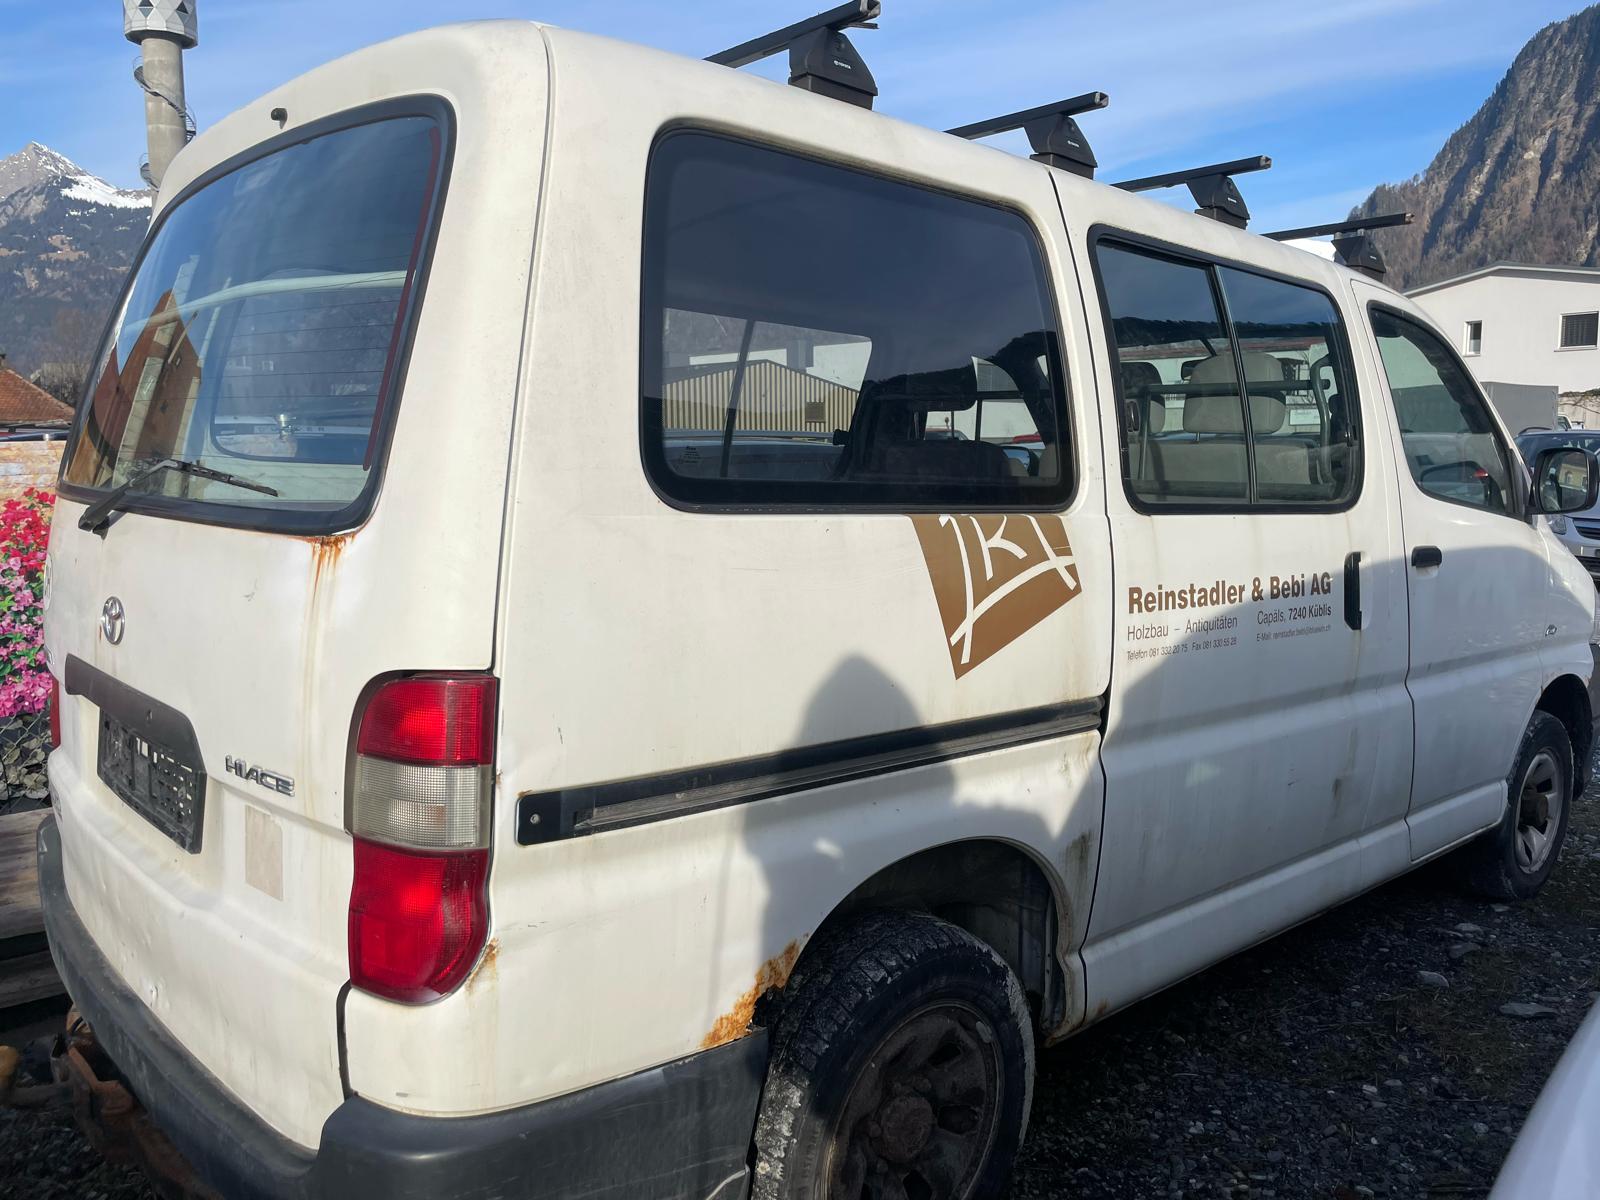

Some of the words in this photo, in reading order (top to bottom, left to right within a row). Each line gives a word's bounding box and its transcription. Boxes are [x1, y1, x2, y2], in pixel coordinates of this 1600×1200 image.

[1128, 579, 1245, 614] Reinstadler
[1251, 576, 1264, 602] &
[1270, 573, 1305, 600] Bebi
[1310, 571, 1331, 596] AG
[1288, 606, 1307, 621] 7240
[1308, 603, 1332, 618] Küblis
[1127, 623, 1169, 641] Holzbau
[1185, 615, 1238, 635] Antiquitäten
[1127, 648, 1148, 661] Telefon
[1149, 647, 1159, 658] 081
[1191, 641, 1201, 651] Fax
[1202, 639, 1212, 649] 081
[225, 754, 295, 797] HIACE
